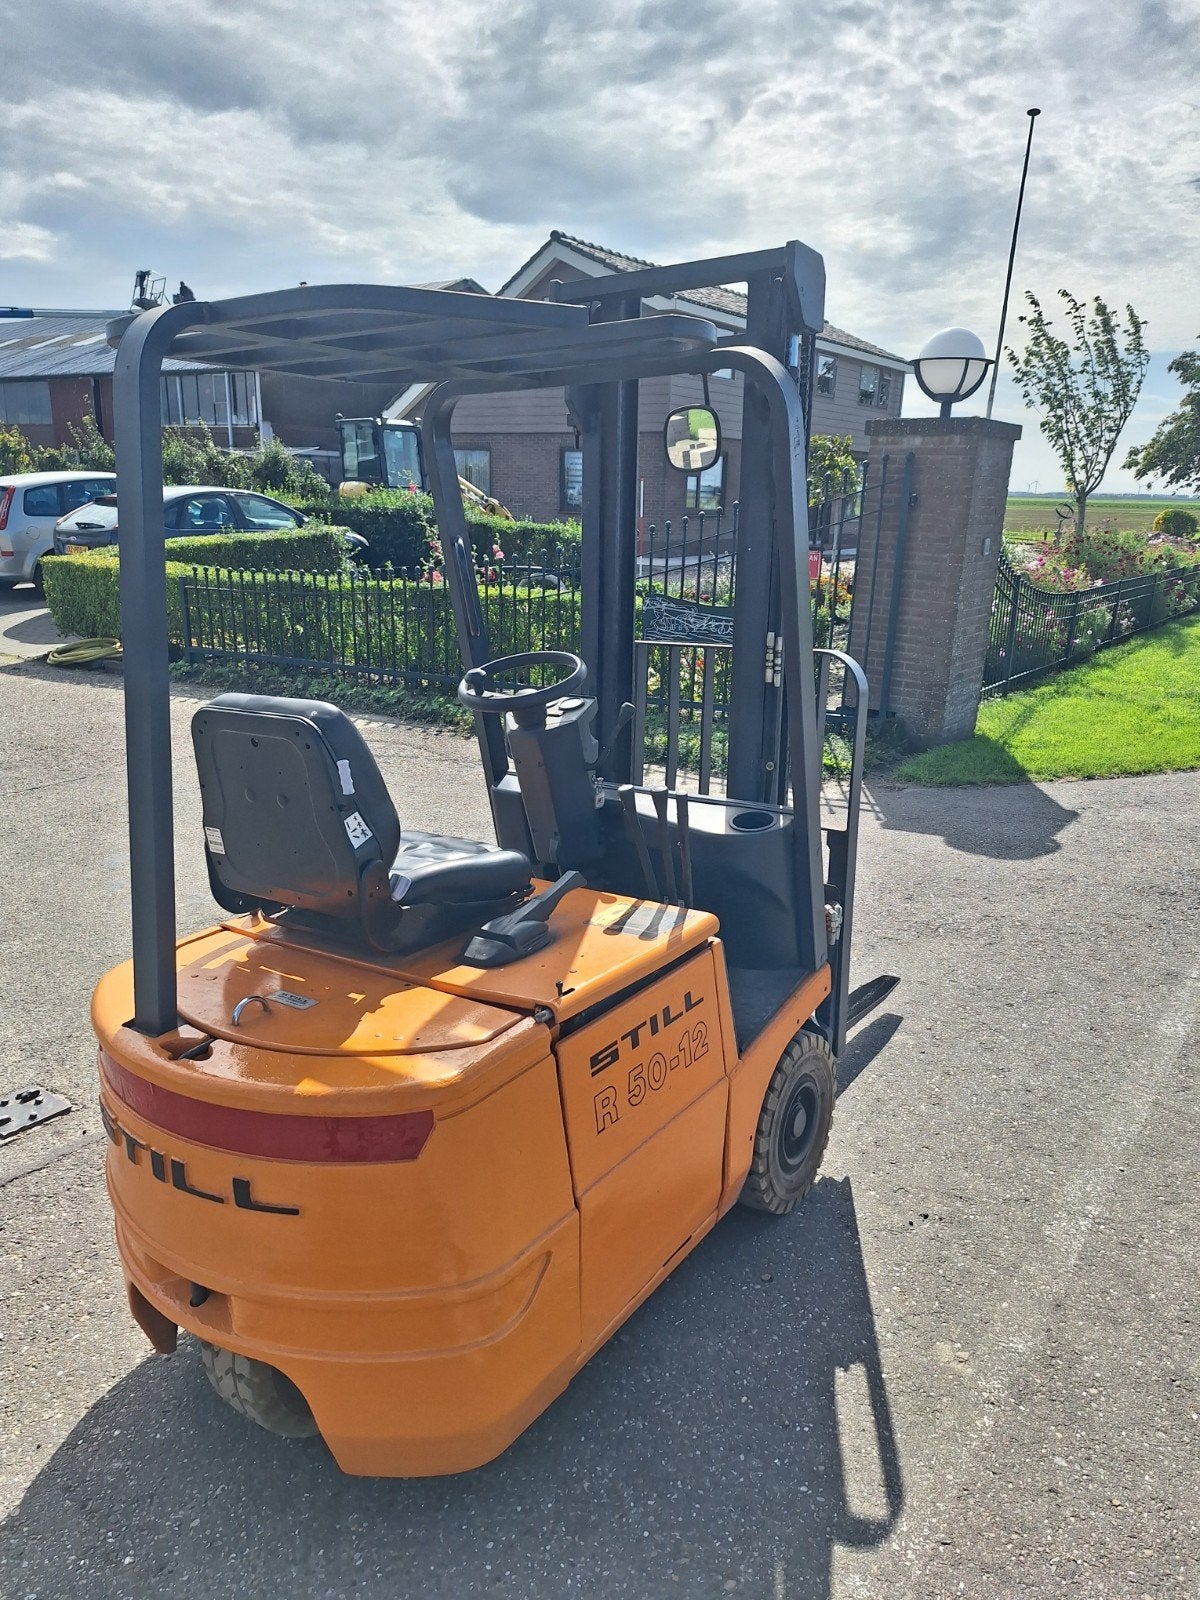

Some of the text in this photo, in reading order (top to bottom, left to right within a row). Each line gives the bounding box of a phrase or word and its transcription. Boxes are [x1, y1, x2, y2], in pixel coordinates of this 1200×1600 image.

[590, 991, 704, 1077] STILL
[594, 1021, 709, 1134] R 50-12
